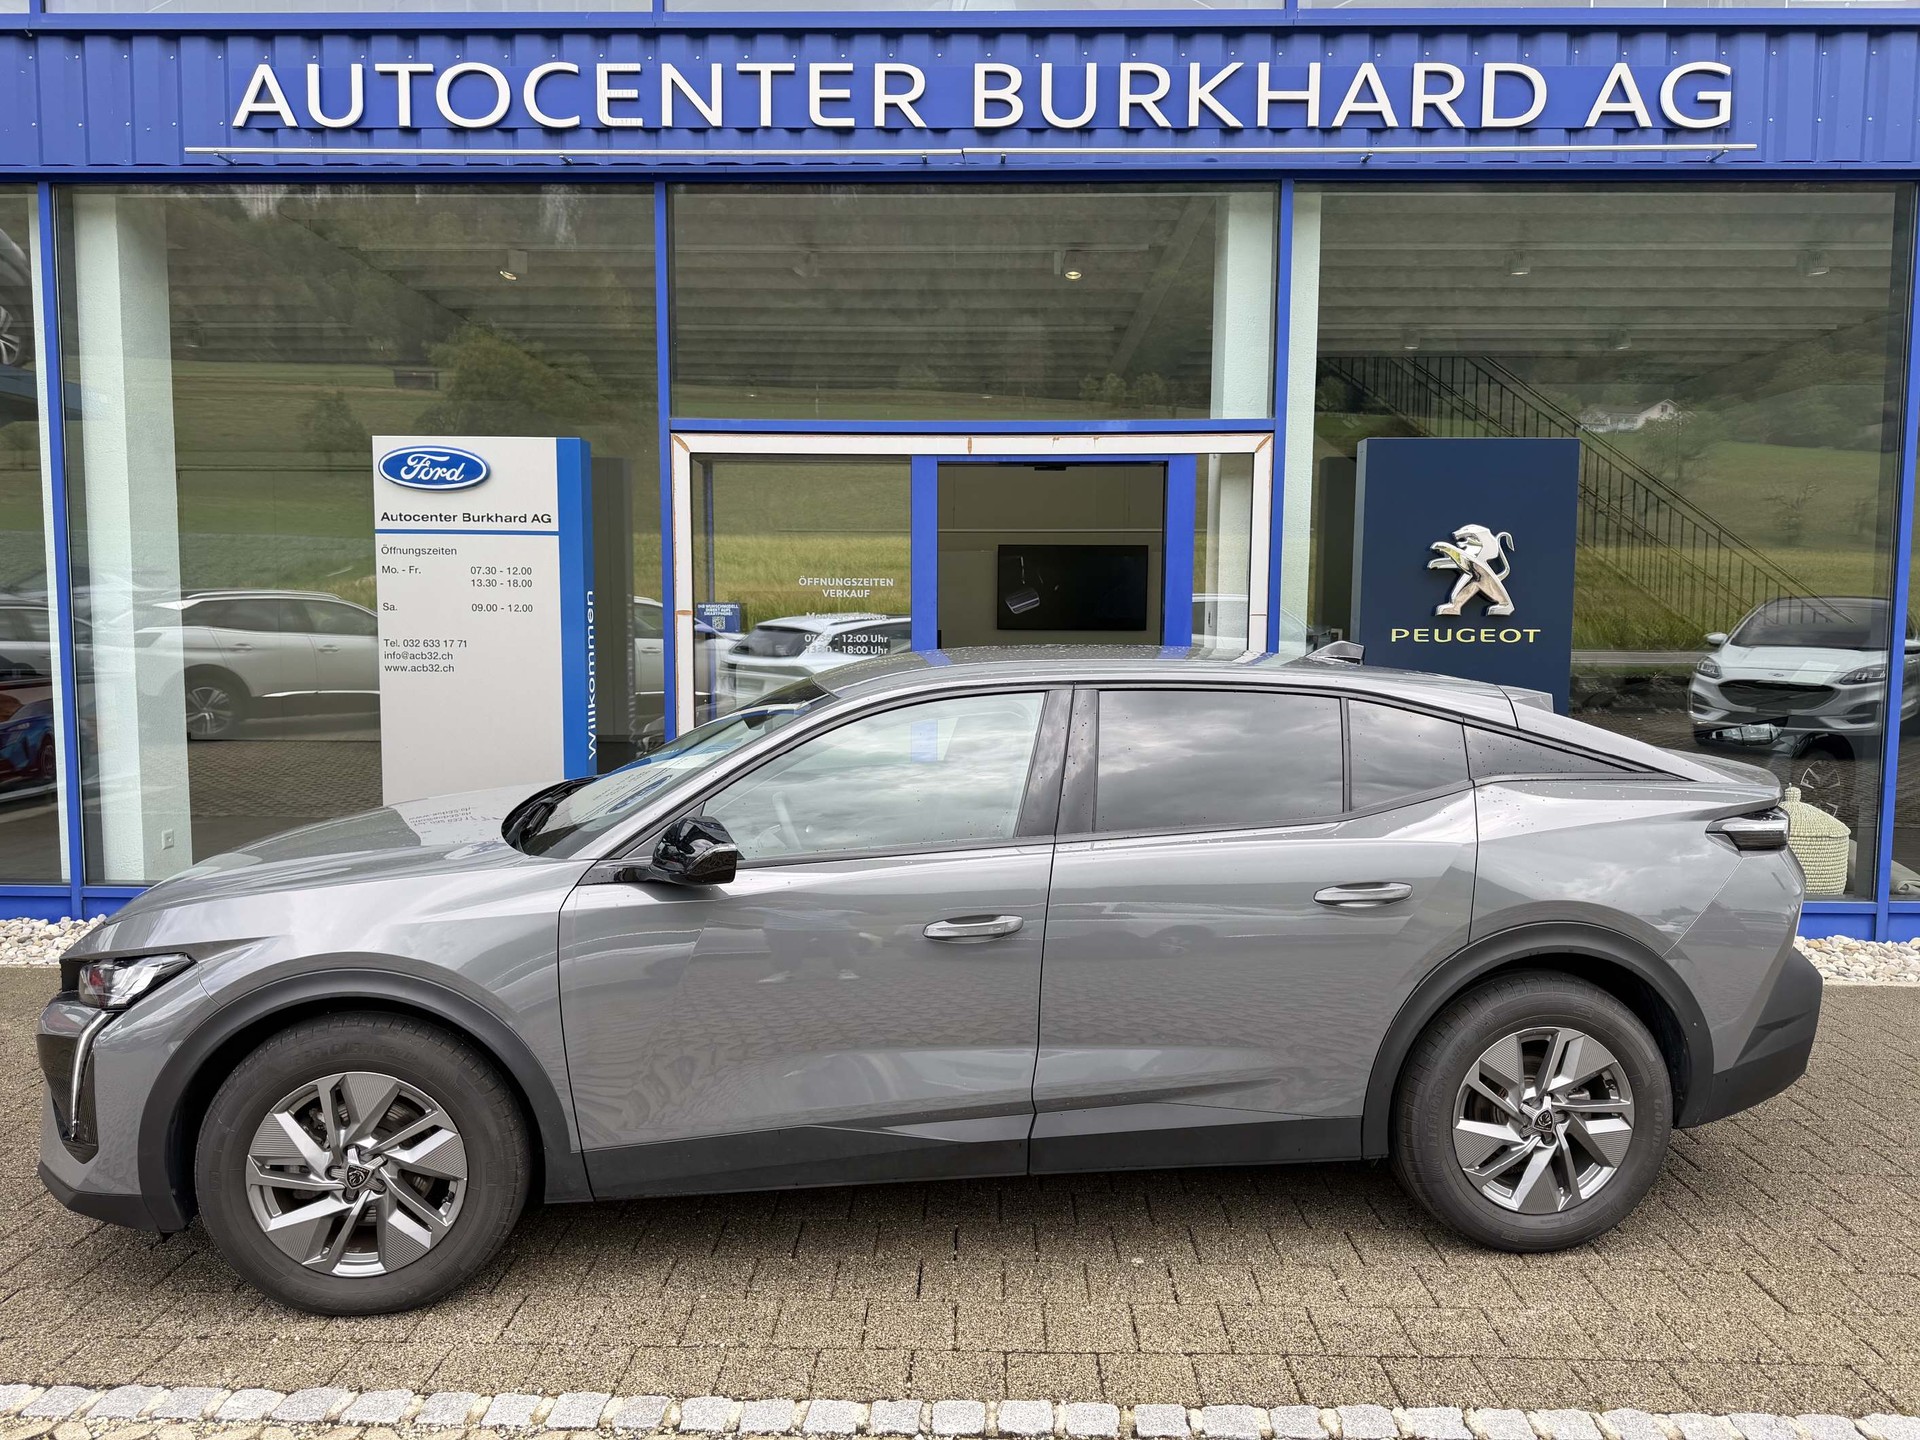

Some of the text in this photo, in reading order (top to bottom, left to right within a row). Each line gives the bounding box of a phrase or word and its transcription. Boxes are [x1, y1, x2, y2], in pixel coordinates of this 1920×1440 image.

[231, 61, 1732, 129] AUTOCENTER BURKHARD AG
[400, 453, 465, 482] Ford
[380, 511, 552, 524] Autocenter Burkhard AG
[380, 544, 457, 557] Öffnungszeiten
[381, 565, 399, 574] Mo.
[408, 566, 421, 574] Fr.
[470, 566, 497, 575] 07.30
[506, 567, 532, 576] 12.00
[471, 579, 497, 588] 13.30
[507, 579, 533, 588] 18.00
[798, 576, 894, 587] ÖFFNUNGSZEITEN
[822, 588, 870, 598] VERKAUF
[382, 602, 398, 611] Sa.
[471, 603, 498, 612] 09.00
[508, 604, 533, 613] 12.00
[842, 634, 868, 643] 12:00
[870, 634, 888, 643] Uhr
[1391, 628, 1541, 643] PEUGEOT
[384, 639, 467, 648] Tel. 032 633 17 71
[842, 645, 868, 654] 18:00
[870, 645, 888, 654] Uhr
[384, 651, 453, 660] info@acb32.ch
[384, 664, 455, 673] www.acb32.ch
[587, 590, 597, 760] Willkommen
